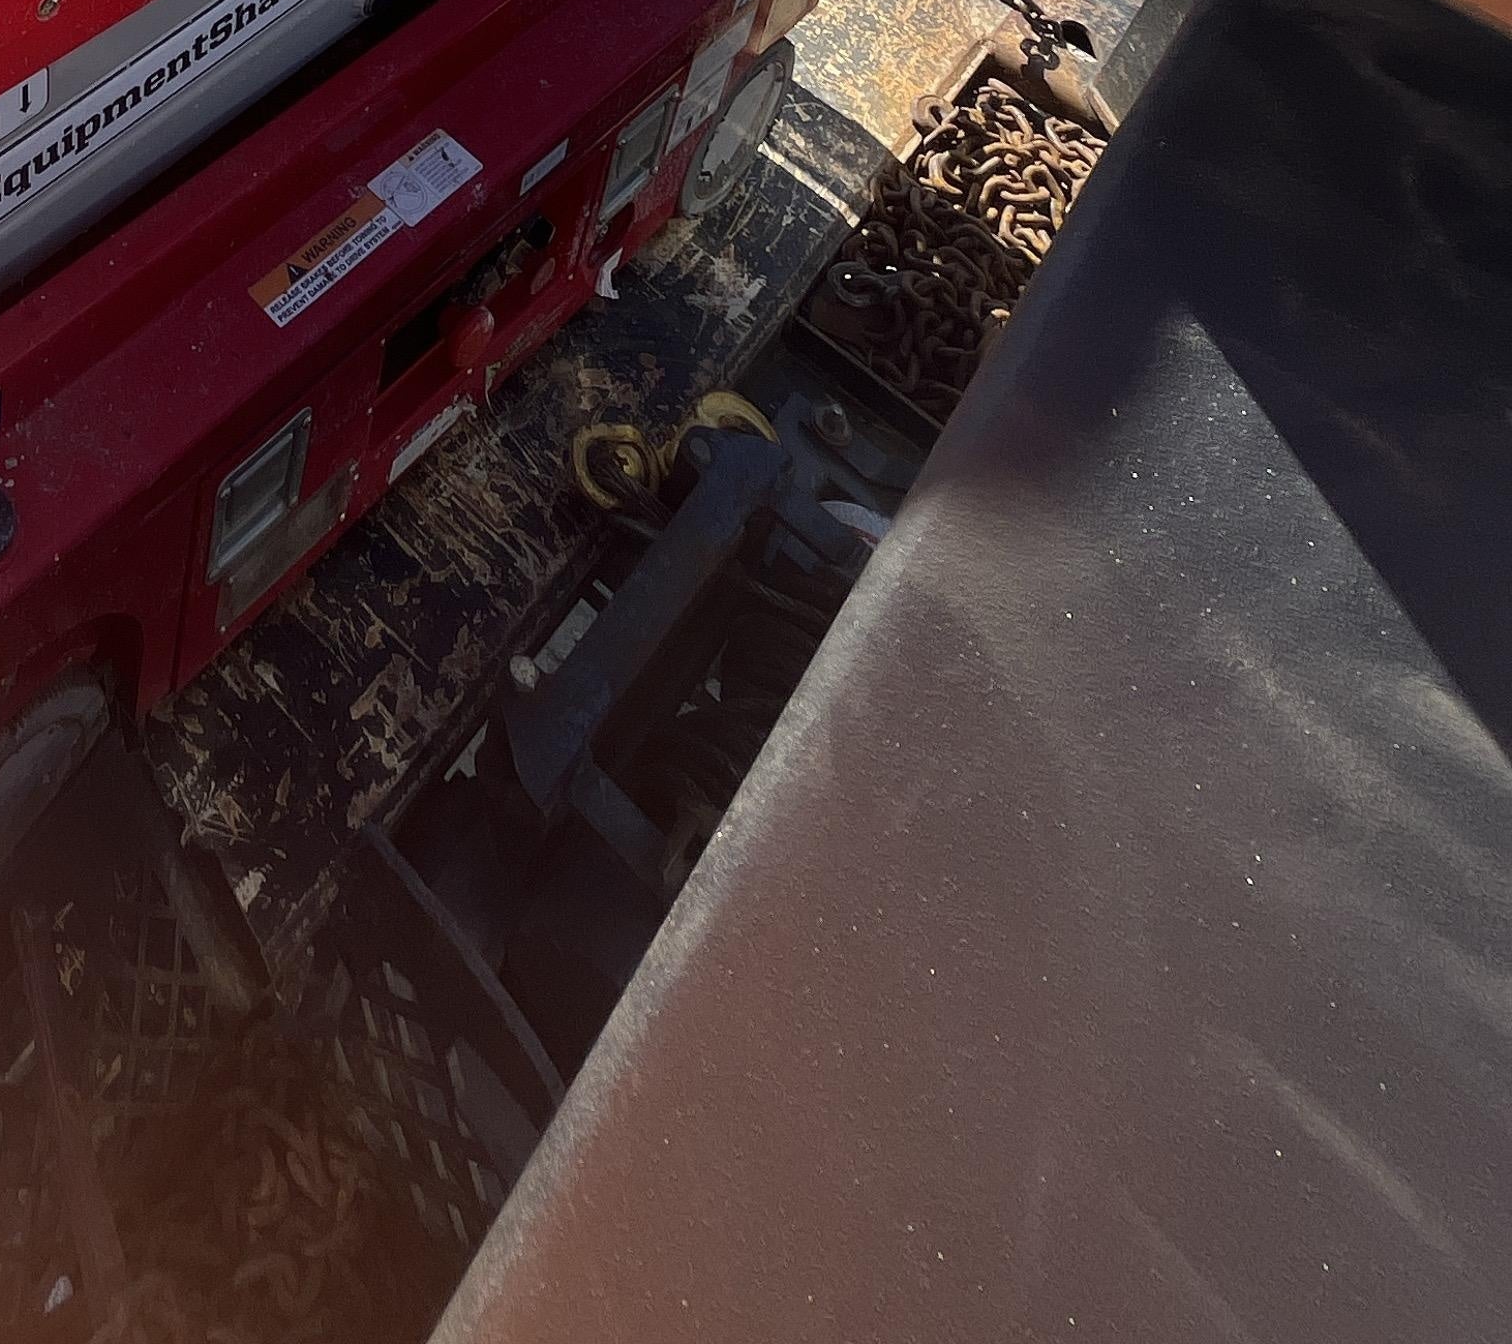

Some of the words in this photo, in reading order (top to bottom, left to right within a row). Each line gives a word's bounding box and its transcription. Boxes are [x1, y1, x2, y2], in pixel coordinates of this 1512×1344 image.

[269, 285, 303, 314] RELEASE
[300, 263, 329, 291] BRAKES
[326, 242, 354, 269] BEFORE
[375, 214, 387, 227] TO
[277, 294, 310, 323] PREVENT
[335, 262, 348, 276] TO
[345, 245, 367, 267] DRIVE
[363, 226, 390, 250] SYSTEM
[301, 216, 357, 263] WARNING
